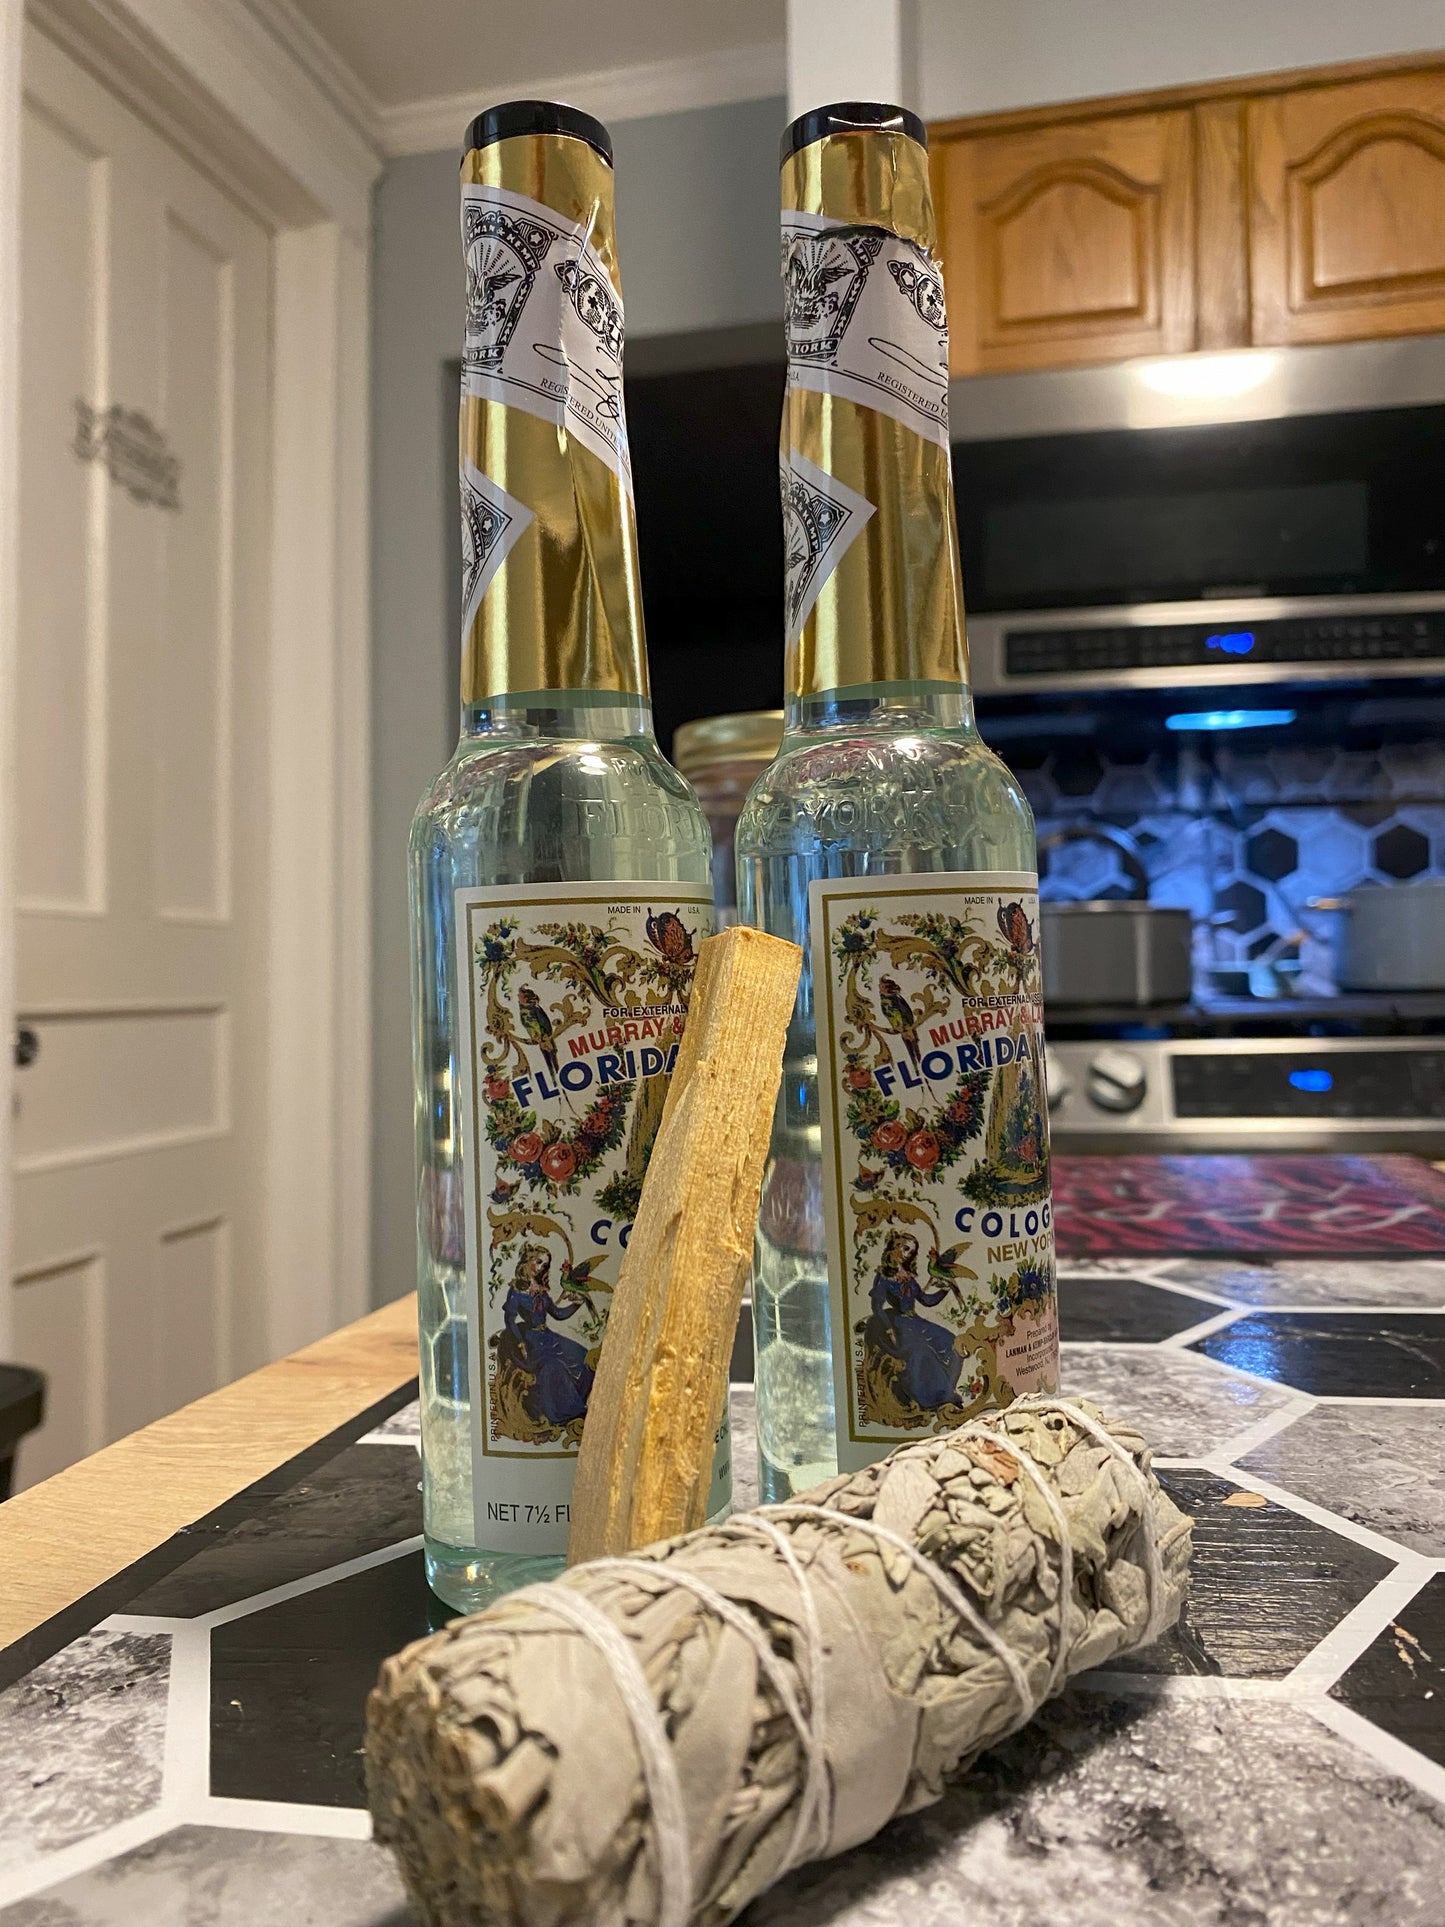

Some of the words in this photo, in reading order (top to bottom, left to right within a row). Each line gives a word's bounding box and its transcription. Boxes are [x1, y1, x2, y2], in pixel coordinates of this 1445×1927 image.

[506, 233, 537, 269] KEMP
[469, 348, 500, 361] ORK
[794, 341, 833, 354] YORK
[540, 377, 594, 420] REGISERED
[877, 371, 939, 413] REGISTERED
[607, 905, 631, 914] MADE
[633, 905, 641, 914] IN
[964, 896, 985, 905] MADE
[986, 896, 994, 905] IN
[603, 1007, 628, 1018] FOR
[633, 1004, 686, 1017] EXTERNAL
[962, 998, 984, 1008] FOR
[988, 993, 1029, 1006] EXTERNAL
[568, 1017, 665, 1058] MURRAY
[672, 1016, 683, 1035] &
[929, 1007, 1014, 1047] MURRAY
[1020, 1006, 1029, 1025] &
[512, 1044, 679, 1108] FLORIDA
[874, 1034, 1031, 1097] FLORIDA
[987, 1240, 1028, 1264] NEW
[487, 1501, 520, 1523] NET
